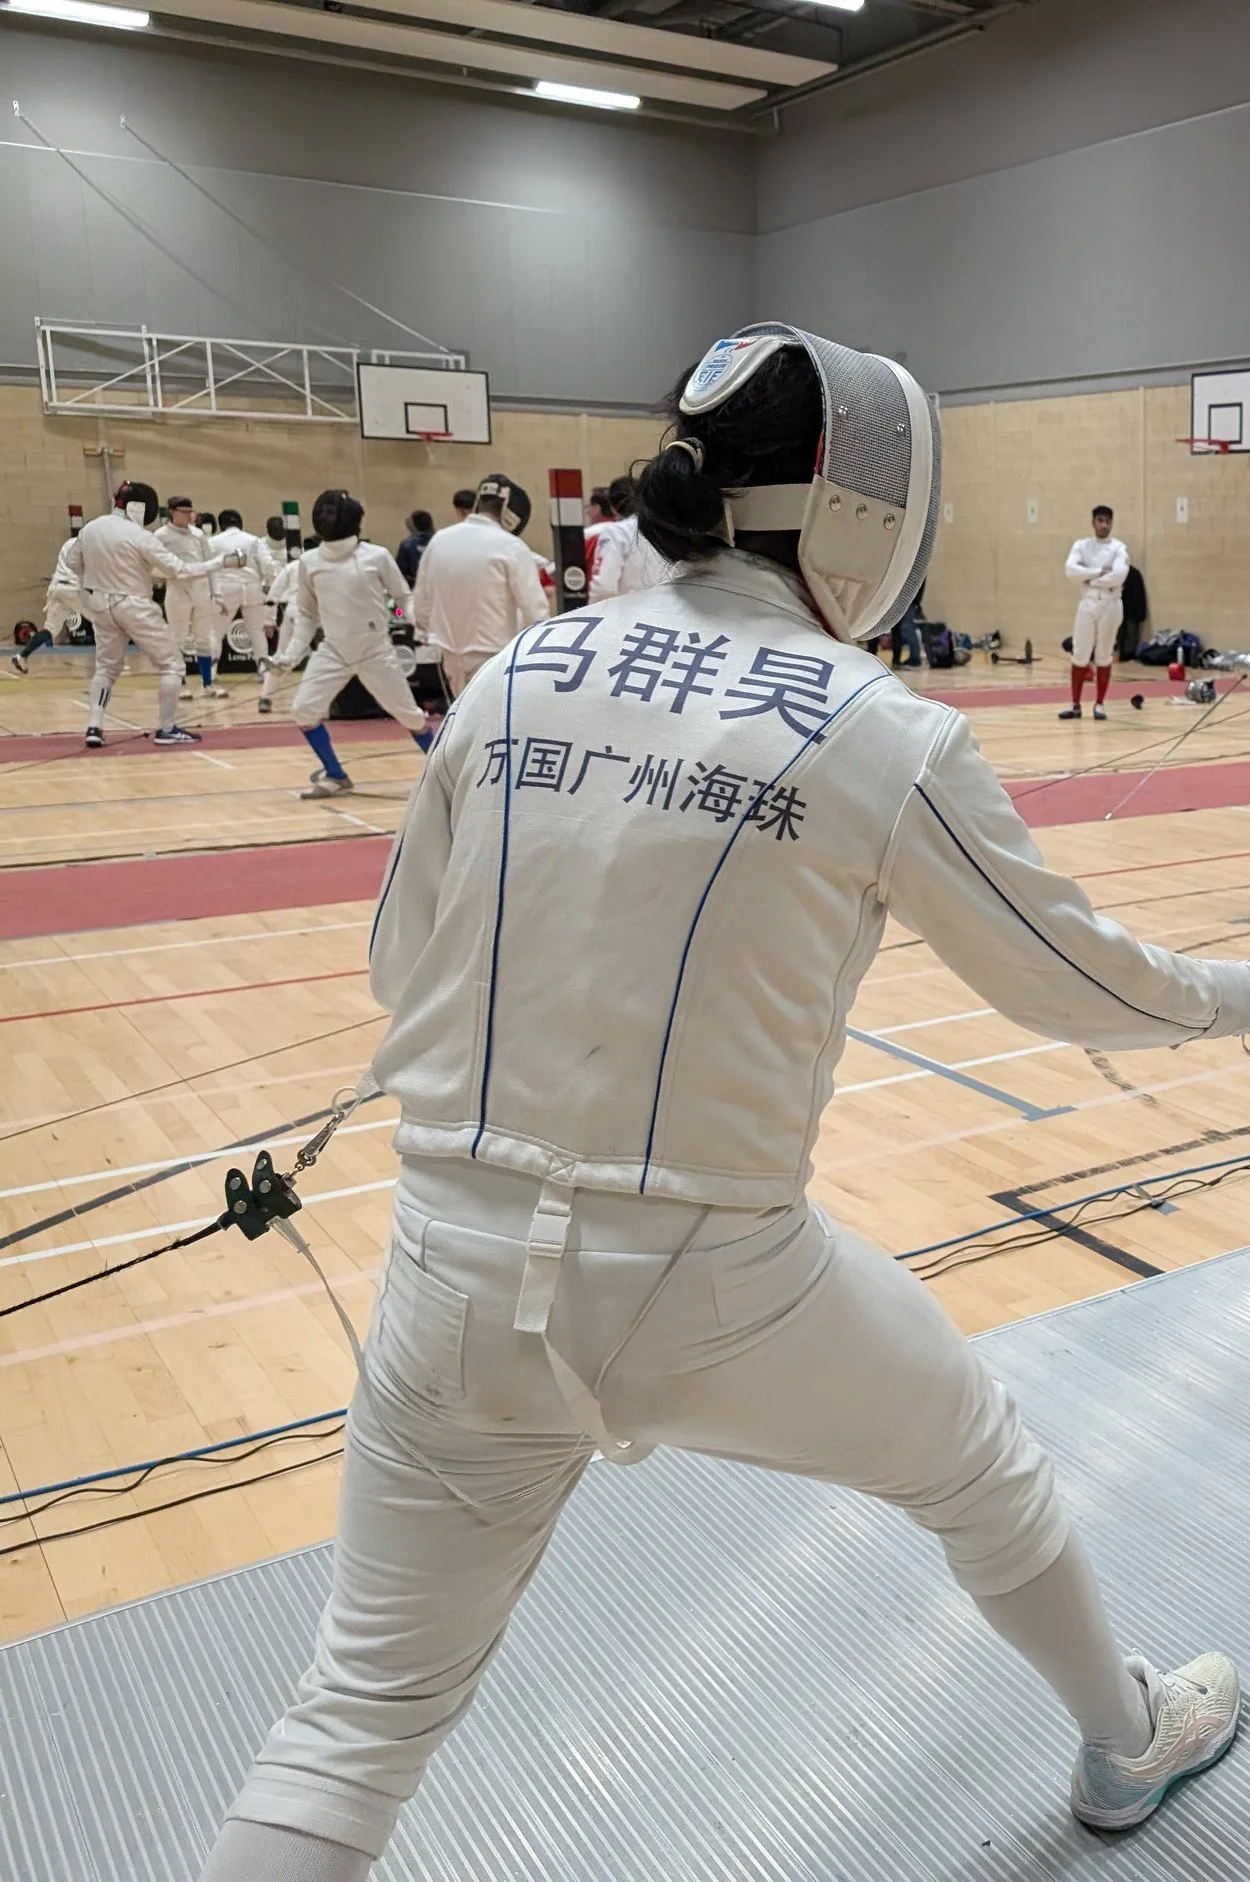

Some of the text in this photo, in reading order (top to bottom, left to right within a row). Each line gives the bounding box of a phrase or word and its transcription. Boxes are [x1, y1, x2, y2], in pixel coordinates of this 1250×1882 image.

[505, 616, 836, 744] 马群昊
[477, 736, 808, 841] 万国广州海珠
